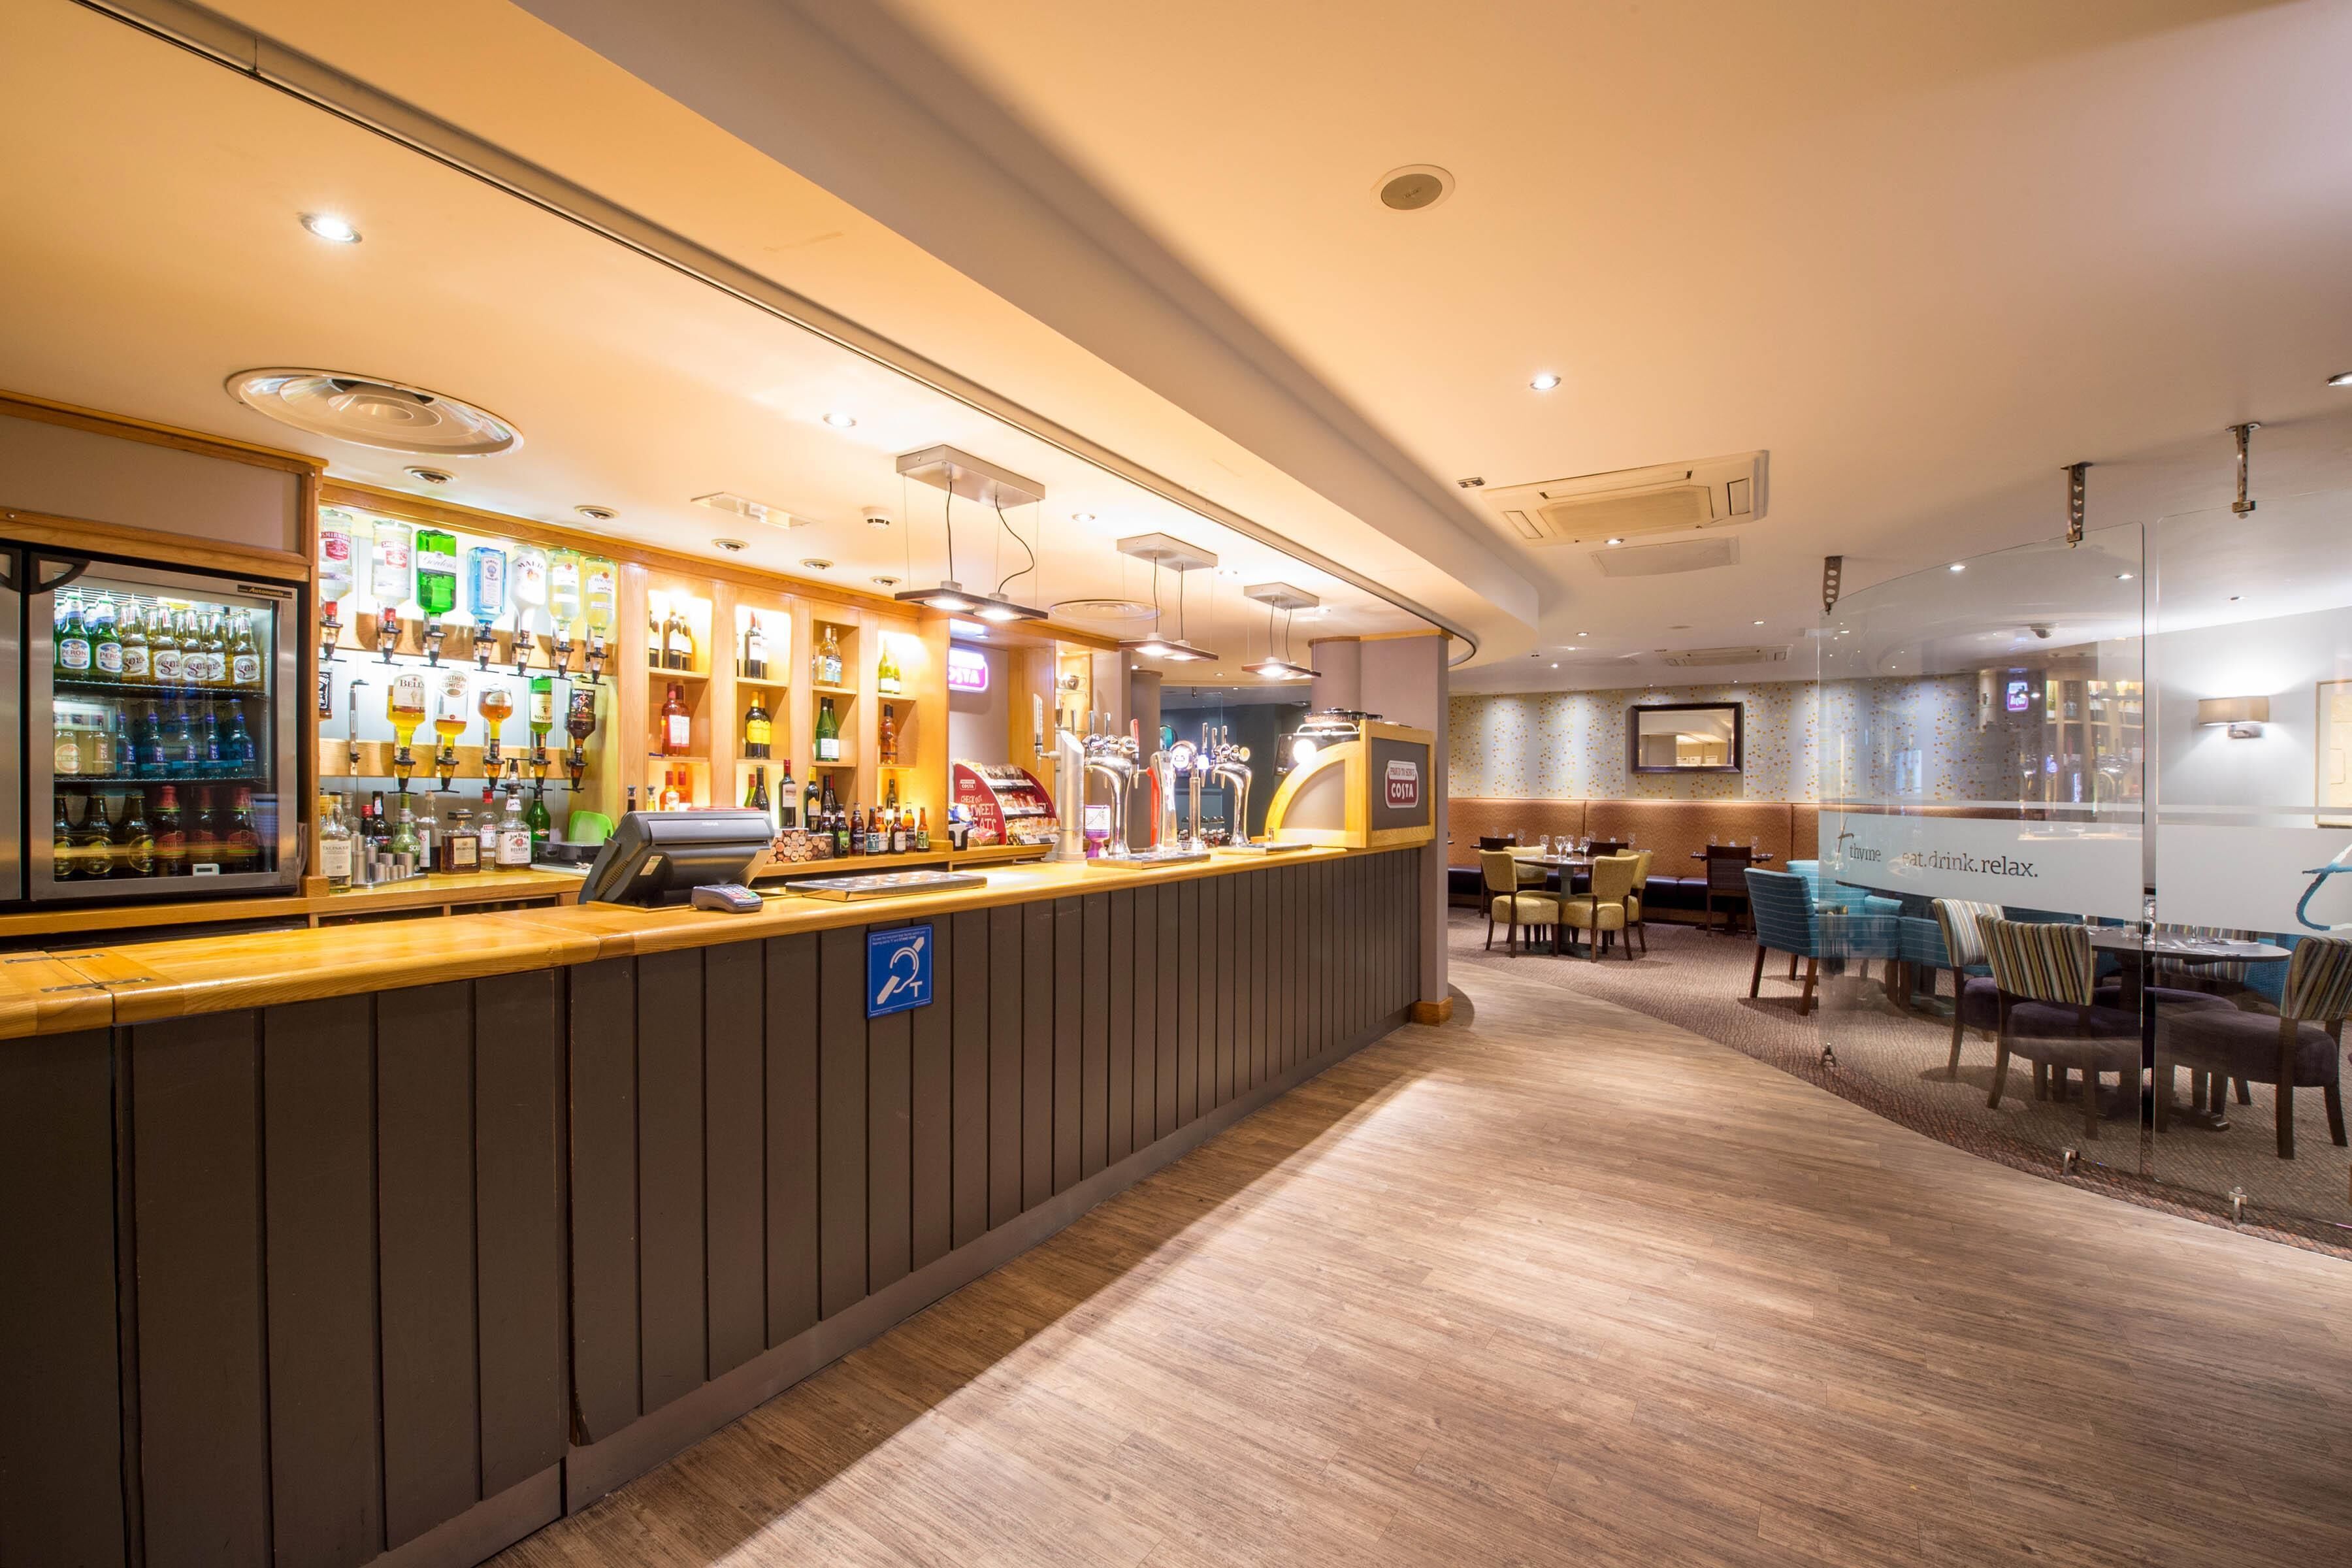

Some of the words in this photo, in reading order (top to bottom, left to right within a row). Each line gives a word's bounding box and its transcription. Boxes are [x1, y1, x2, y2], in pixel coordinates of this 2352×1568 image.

[961, 795, 974, 804] CHECK
[1391, 783, 1414, 800] COSTA
[1850, 843, 1882, 862] thyme
